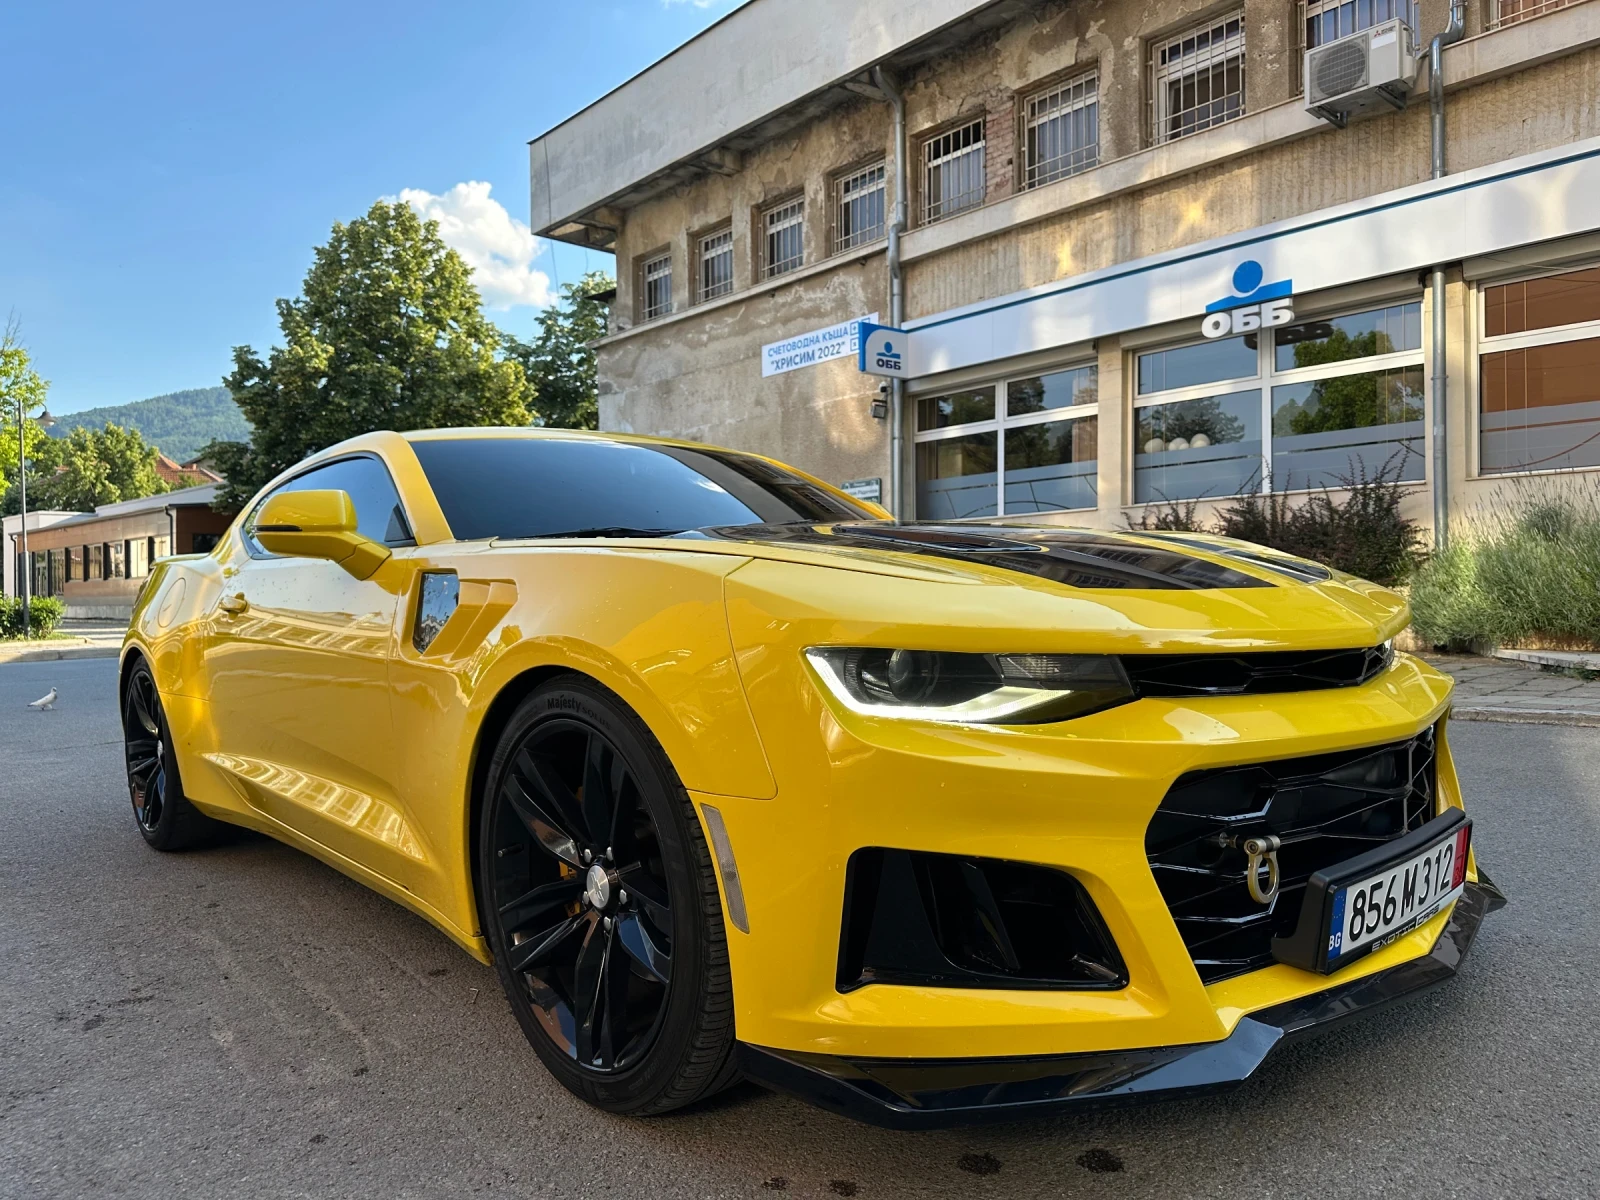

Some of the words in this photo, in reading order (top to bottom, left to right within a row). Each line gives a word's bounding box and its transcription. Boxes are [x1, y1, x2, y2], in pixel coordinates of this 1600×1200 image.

[1201, 298, 1294, 338] ОББ
[767, 336, 821, 358] СЧЕТОВОДНА
[822, 326, 849, 343] КЪЩА
[770, 350, 816, 371] "ХРИСИМ
[817, 341, 846, 360] 2022"
[876, 358, 902, 370] ОББ
[547, 694, 581, 712] Majesty
[1329, 931, 1342, 951] BG
[1371, 920, 1415, 951] EXOTIC
